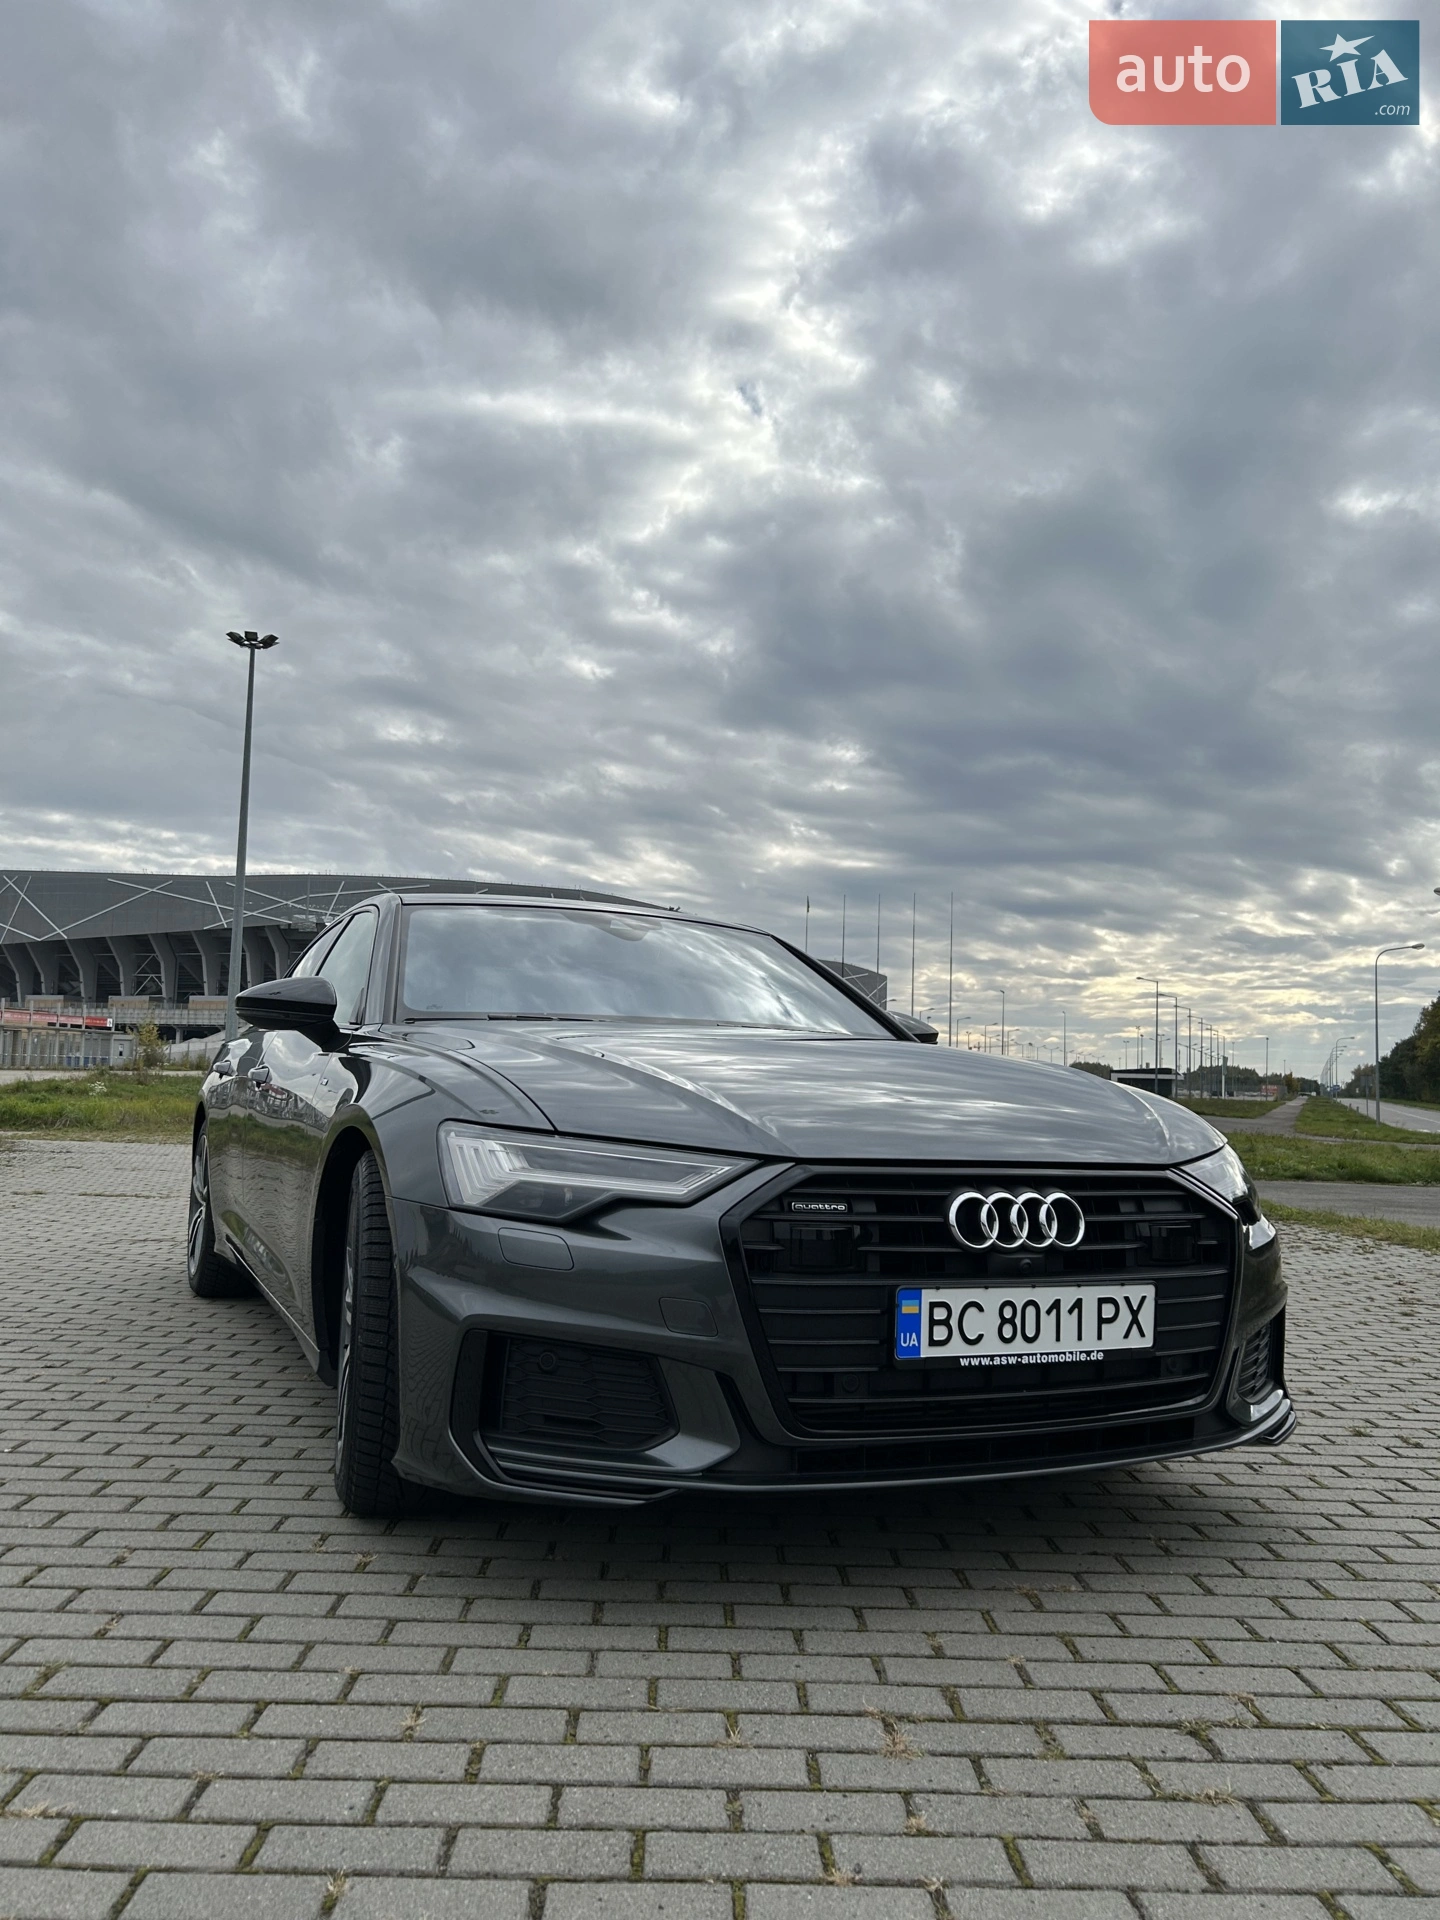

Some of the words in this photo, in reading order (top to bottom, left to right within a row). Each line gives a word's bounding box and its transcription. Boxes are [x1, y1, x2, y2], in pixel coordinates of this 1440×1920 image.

[794, 1203, 846, 1211] quattro
[928, 1300, 985, 1347] BC
[997, 1298, 1083, 1344] 8011
[1096, 1295, 1148, 1341] PX
[900, 1332, 919, 1347] UA
[959, 1350, 1105, 1366] www.asw-automobile.de
